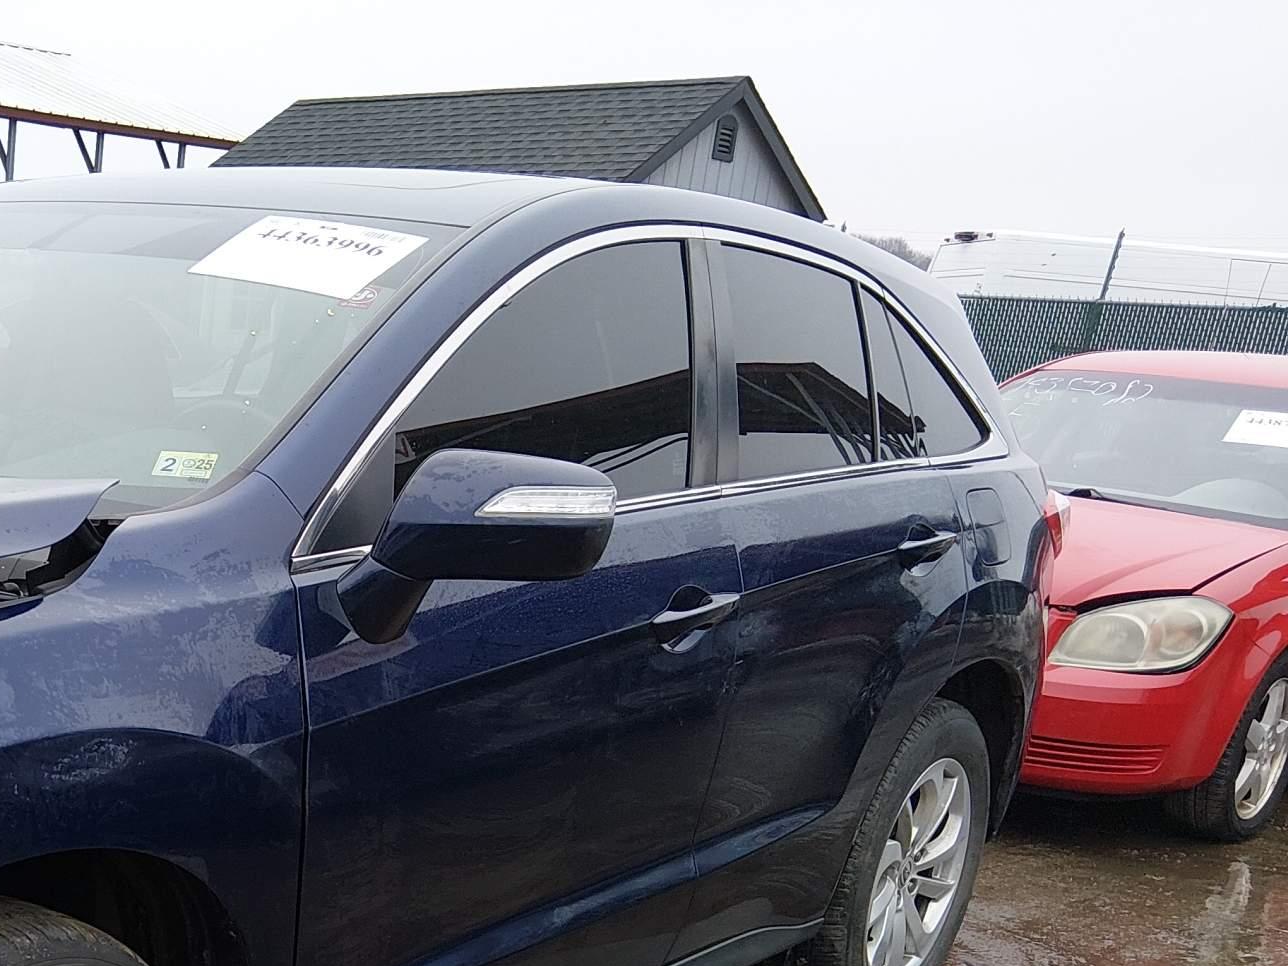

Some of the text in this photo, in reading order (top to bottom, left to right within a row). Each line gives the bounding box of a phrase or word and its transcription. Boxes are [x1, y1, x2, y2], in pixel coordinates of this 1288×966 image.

[257, 228, 385, 258] 44363996
[160, 457, 177, 472] 2
[195, 459, 214, 471] 25
